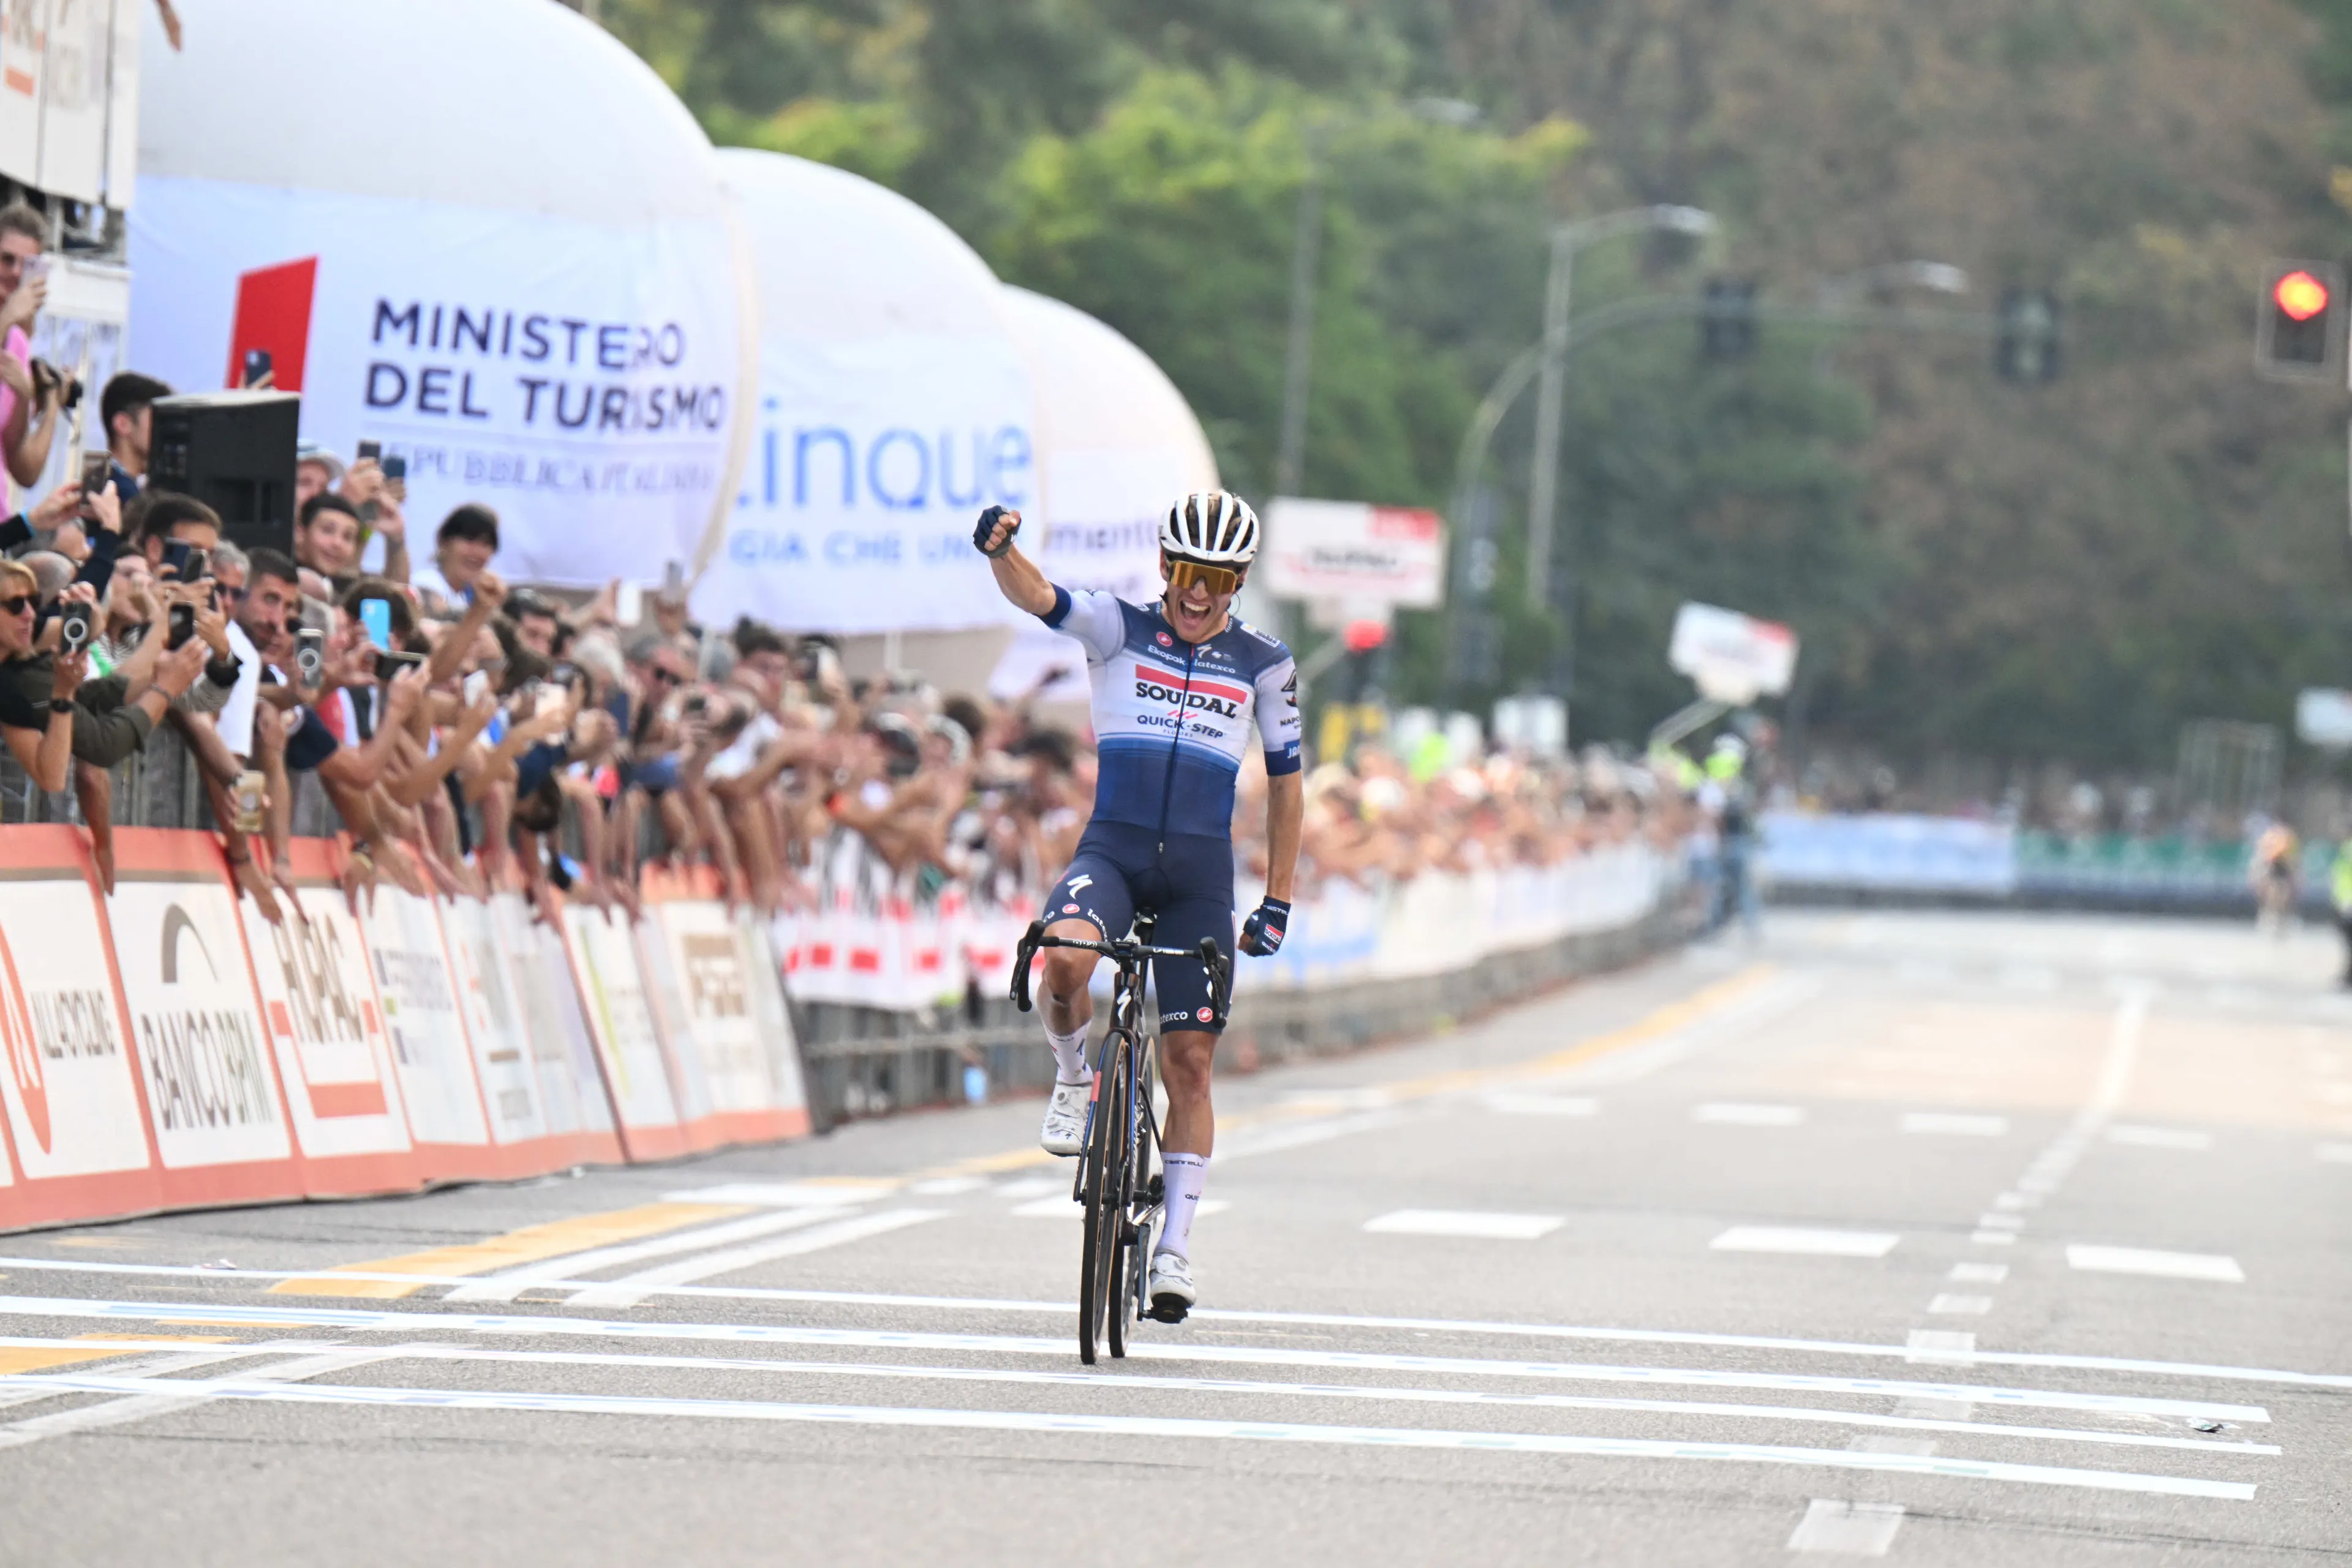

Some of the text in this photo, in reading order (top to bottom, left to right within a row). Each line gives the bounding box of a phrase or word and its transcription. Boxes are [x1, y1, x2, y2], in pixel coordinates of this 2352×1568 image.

[372, 298, 684, 371] MINISTERO
[364, 362, 726, 431] DEL TURISMO
[737, 397, 1033, 510] inque
[1148, 644, 1235, 674] Ekopak latexco
[1136, 682, 1237, 718] SOUDAL
[141, 1011, 230, 1129] BANCO
